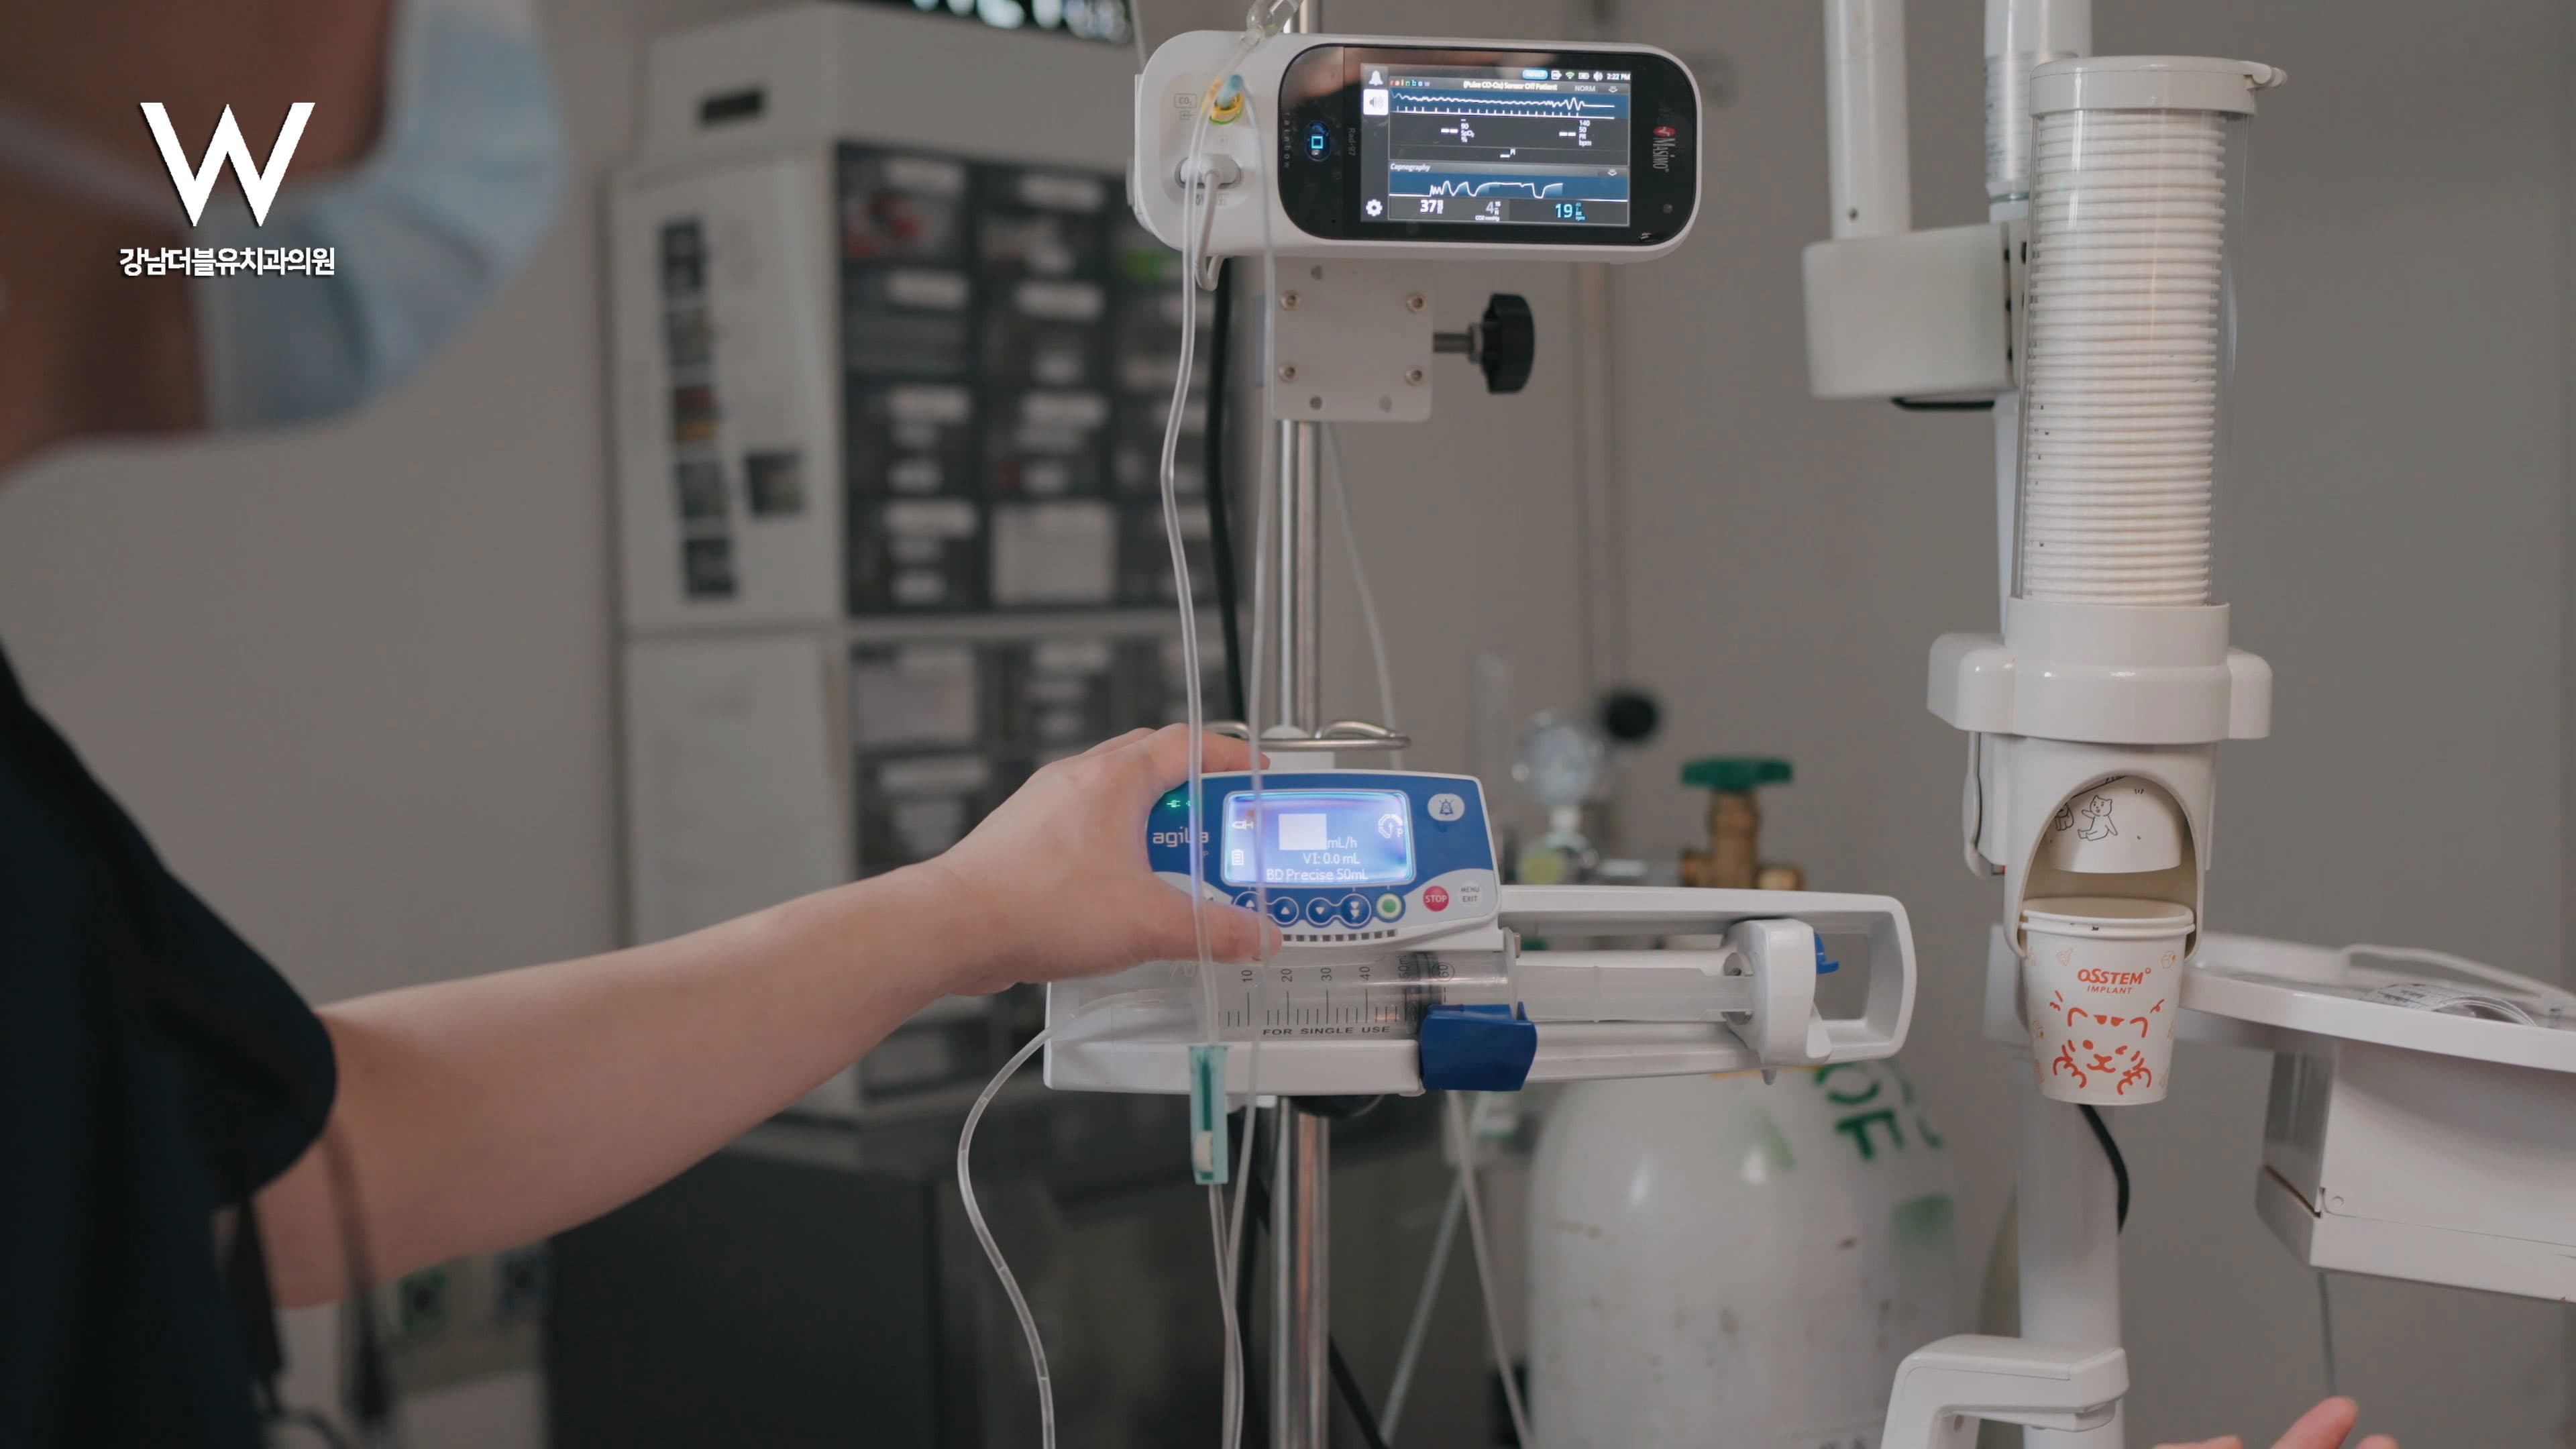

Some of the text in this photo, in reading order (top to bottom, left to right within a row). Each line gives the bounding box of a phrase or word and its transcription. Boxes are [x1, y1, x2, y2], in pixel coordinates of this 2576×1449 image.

[1391, 163, 1430, 172] Capnography
[1420, 200, 1437, 213] 37
[1555, 203, 1572, 218] 19
[1152, 826, 1209, 847] agila
[1323, 853, 1340, 864] 0.0
[1342, 853, 1360, 865] mL
[1267, 867, 1368, 881] BD Precise 50mL
[1426, 894, 1447, 903] STOP
[1241, 969, 1252, 983] 10
[1281, 968, 1292, 982] 20
[1320, 967, 1332, 981] 30
[1359, 966, 1371, 981] 40
[2078, 968, 2143, 985] OSSTEM
[2087, 985, 2133, 994] IMPLANT
